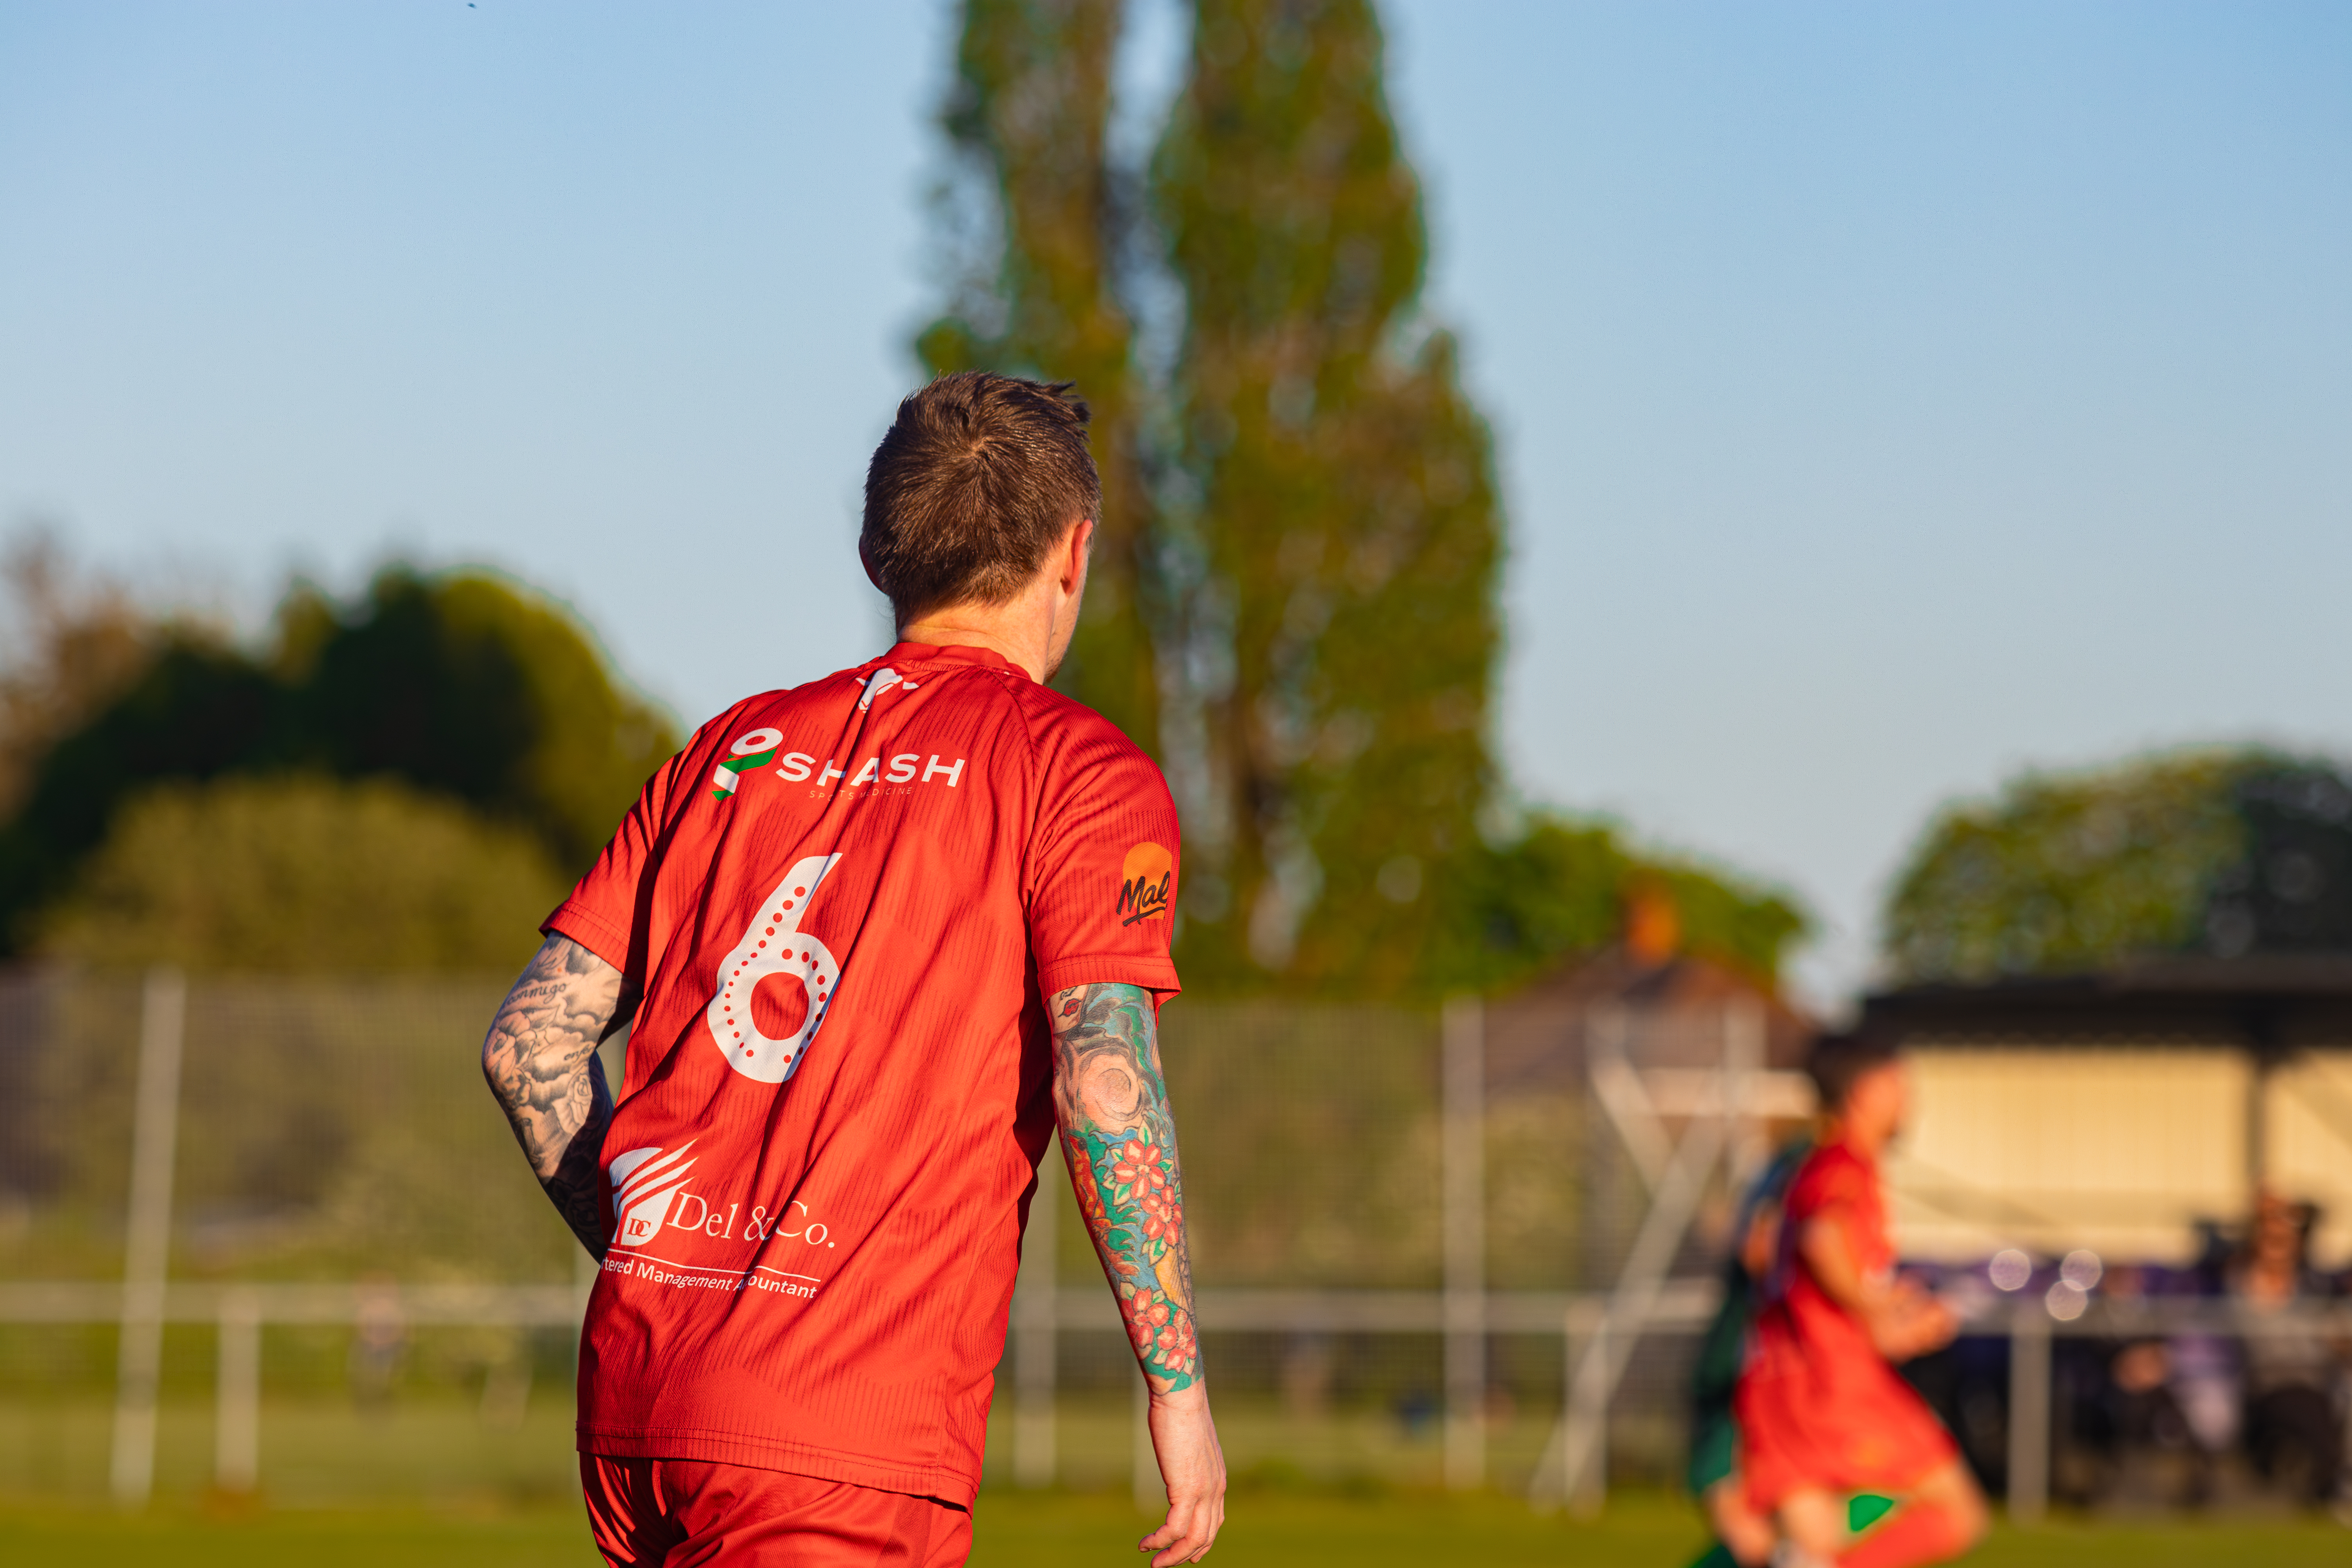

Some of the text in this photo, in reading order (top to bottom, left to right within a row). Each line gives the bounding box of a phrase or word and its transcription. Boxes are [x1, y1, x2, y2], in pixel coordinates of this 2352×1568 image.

[776, 752, 965, 788] SHASH
[809, 790, 855, 801] SPOTS
[707, 852, 843, 1083] 6
[627, 1218, 651, 1237] DC
[666, 1191, 835, 1248] Del & Co.
[600, 1256, 817, 1299] rtered Management Aountant
